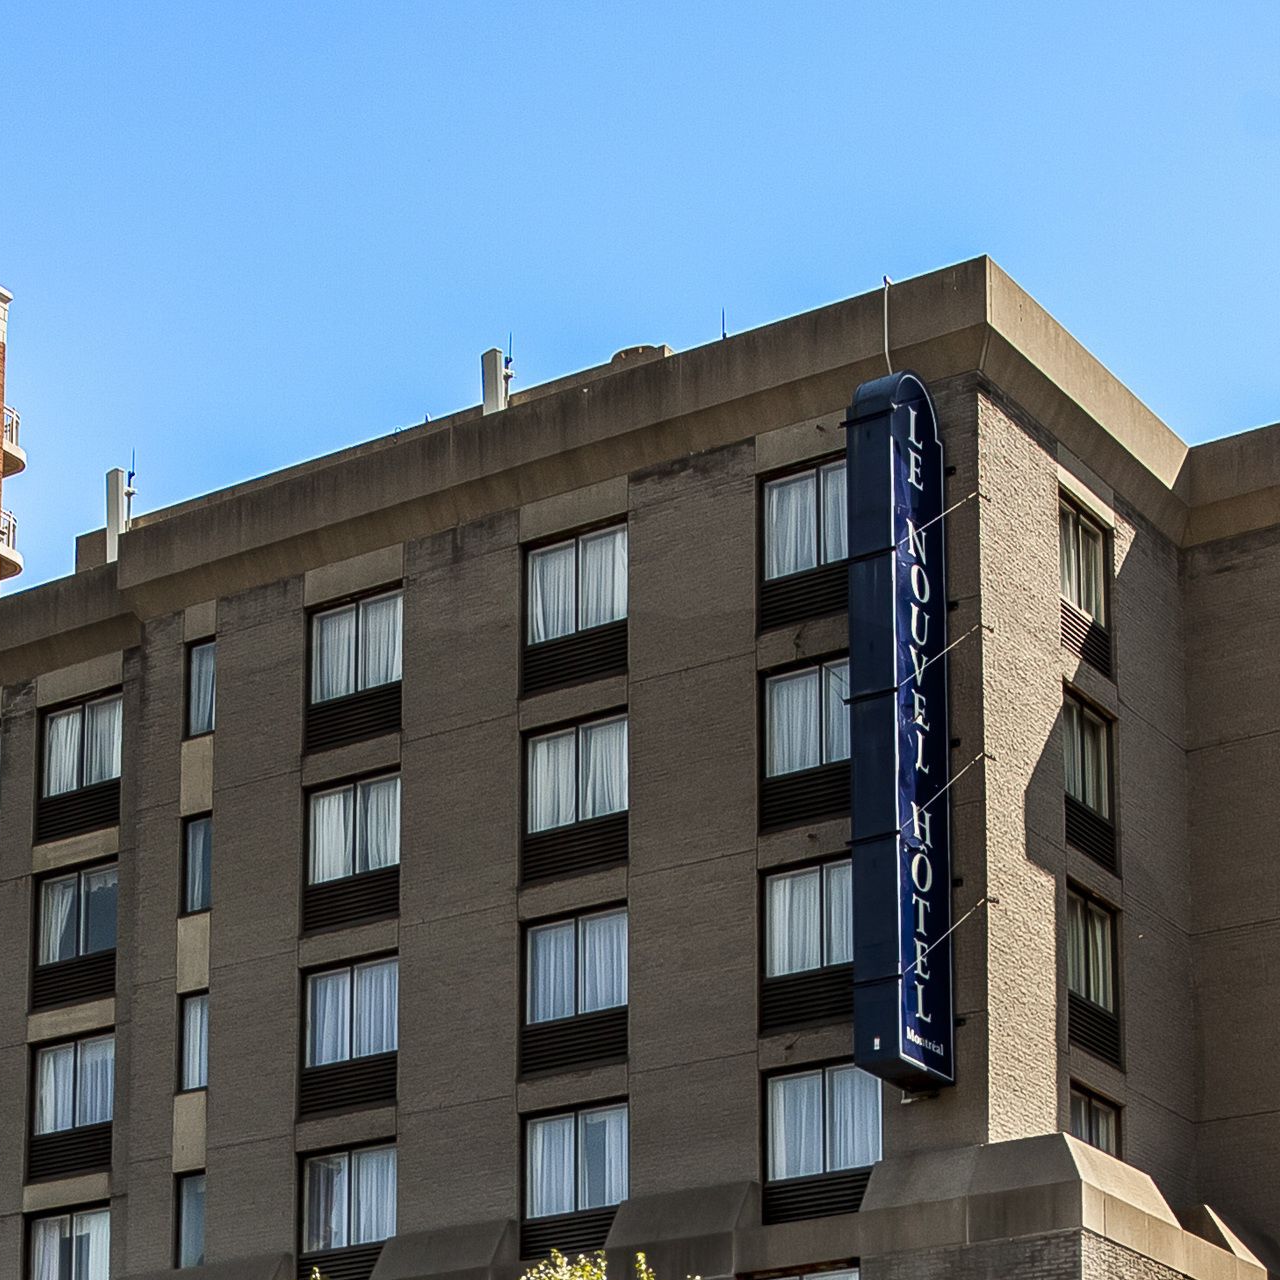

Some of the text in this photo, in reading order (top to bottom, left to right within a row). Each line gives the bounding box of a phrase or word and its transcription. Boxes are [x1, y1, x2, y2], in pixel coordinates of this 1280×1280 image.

[906, 405, 933, 1023] LE NOUVEL HÔTEL
[906, 1025, 944, 1056] Montréal
